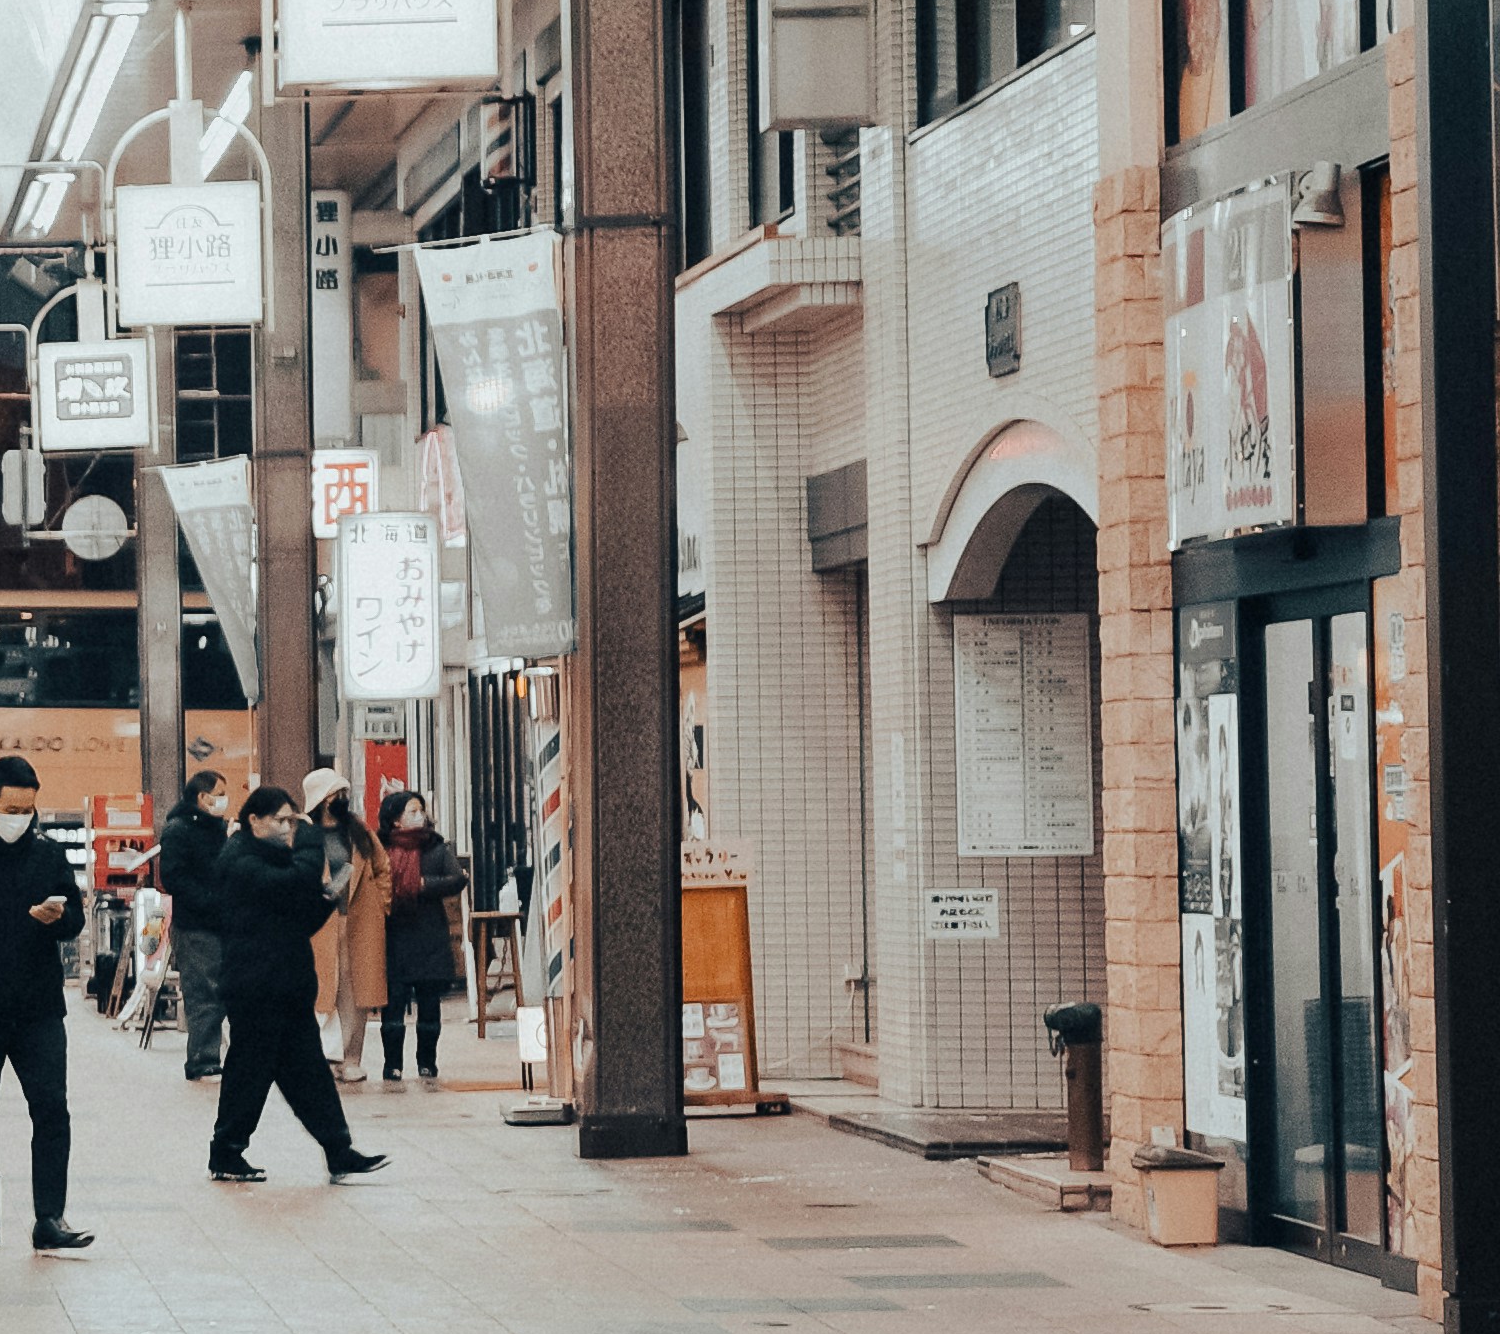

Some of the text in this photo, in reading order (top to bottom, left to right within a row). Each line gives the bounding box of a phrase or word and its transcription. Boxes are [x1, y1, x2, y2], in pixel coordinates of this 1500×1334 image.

[148, 233, 232, 262] 狸小路
[350, 522, 428, 544] 北海道
[355, 596, 384, 678] ワイン
[395, 556, 425, 663] おみやげ
